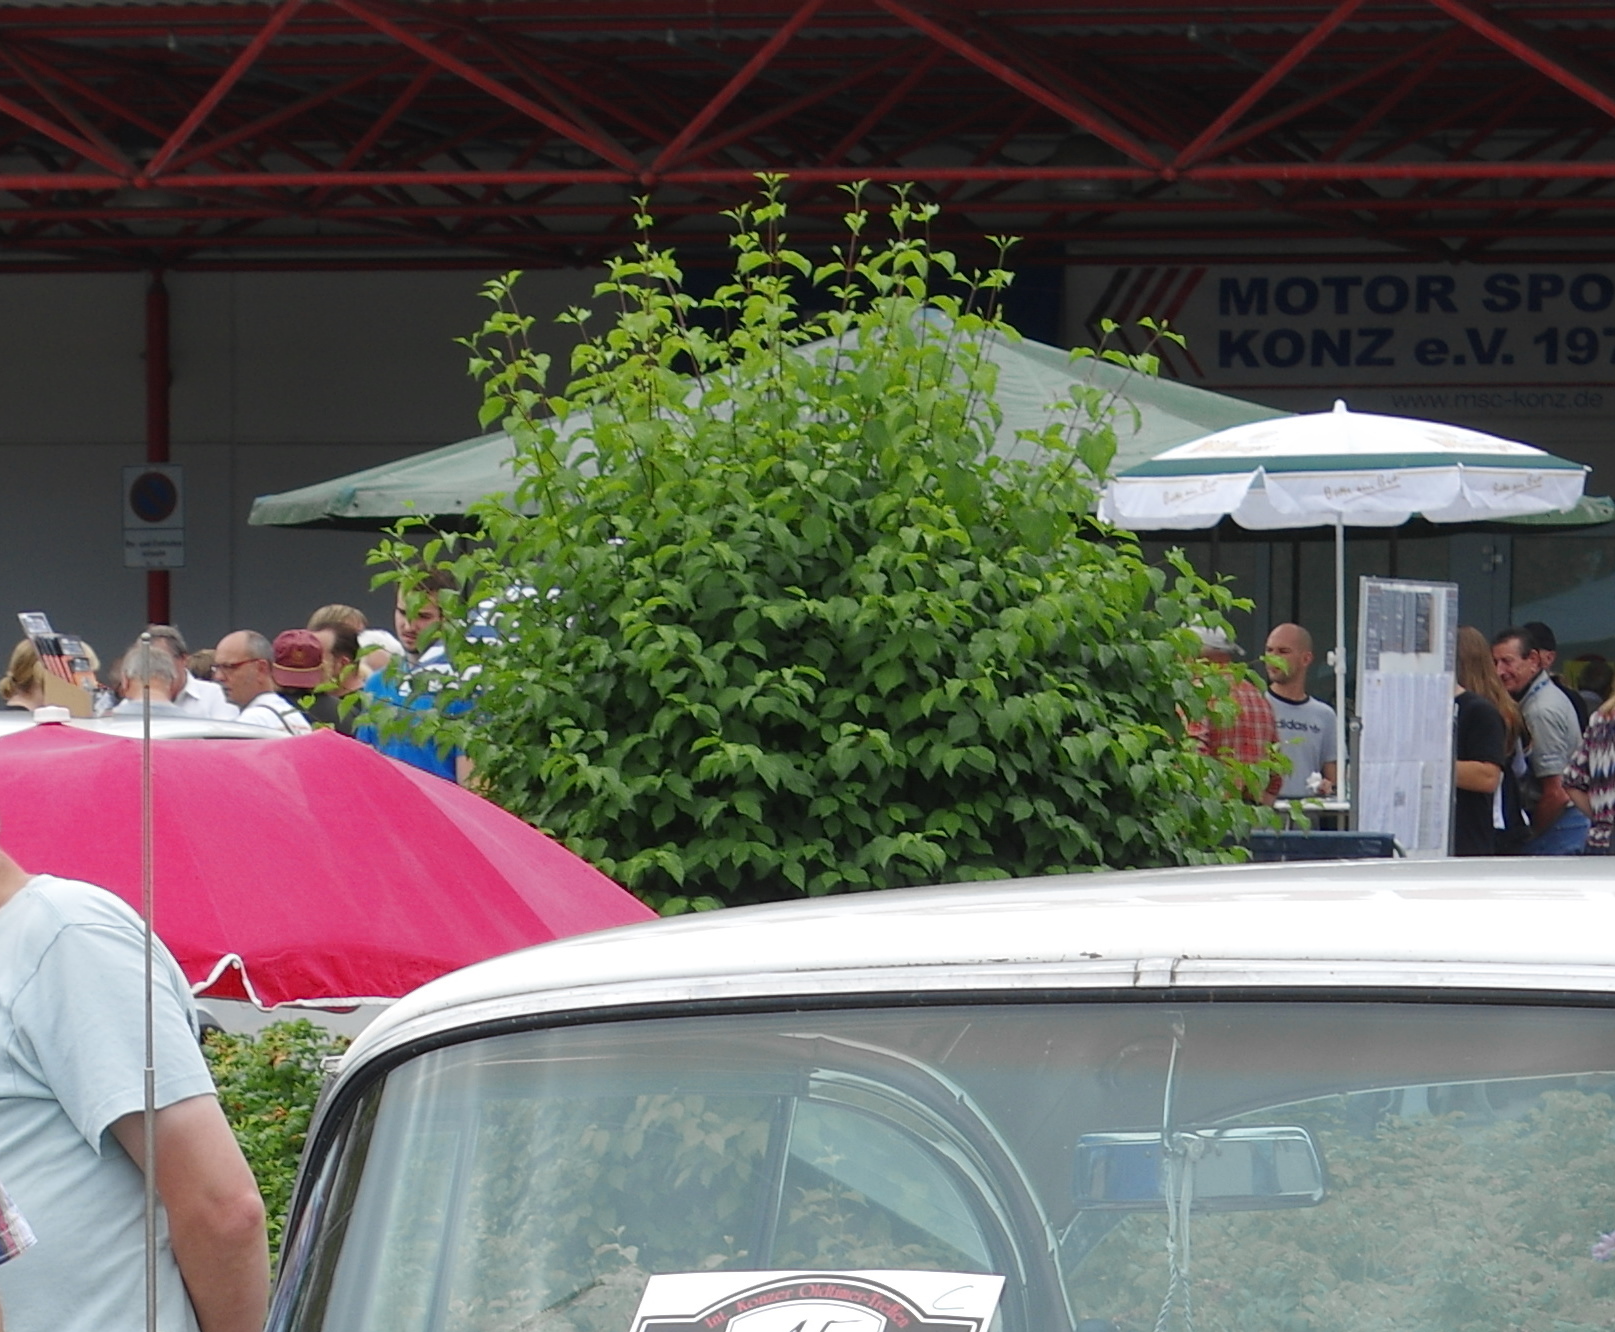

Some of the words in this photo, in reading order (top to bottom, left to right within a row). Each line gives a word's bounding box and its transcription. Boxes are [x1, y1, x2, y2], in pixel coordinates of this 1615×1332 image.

[1218, 274, 1458, 316] MOTOR
[1218, 327, 1395, 368] KONZ
[1414, 328, 1515, 366] e.V.
[1390, 391, 1604, 409] www.msc-konz.de
[705, 1311, 729, 1329] Int.
[736, 1287, 794, 1311] Konzer
[799, 1283, 910, 1329] Oldtimer-Treffen
